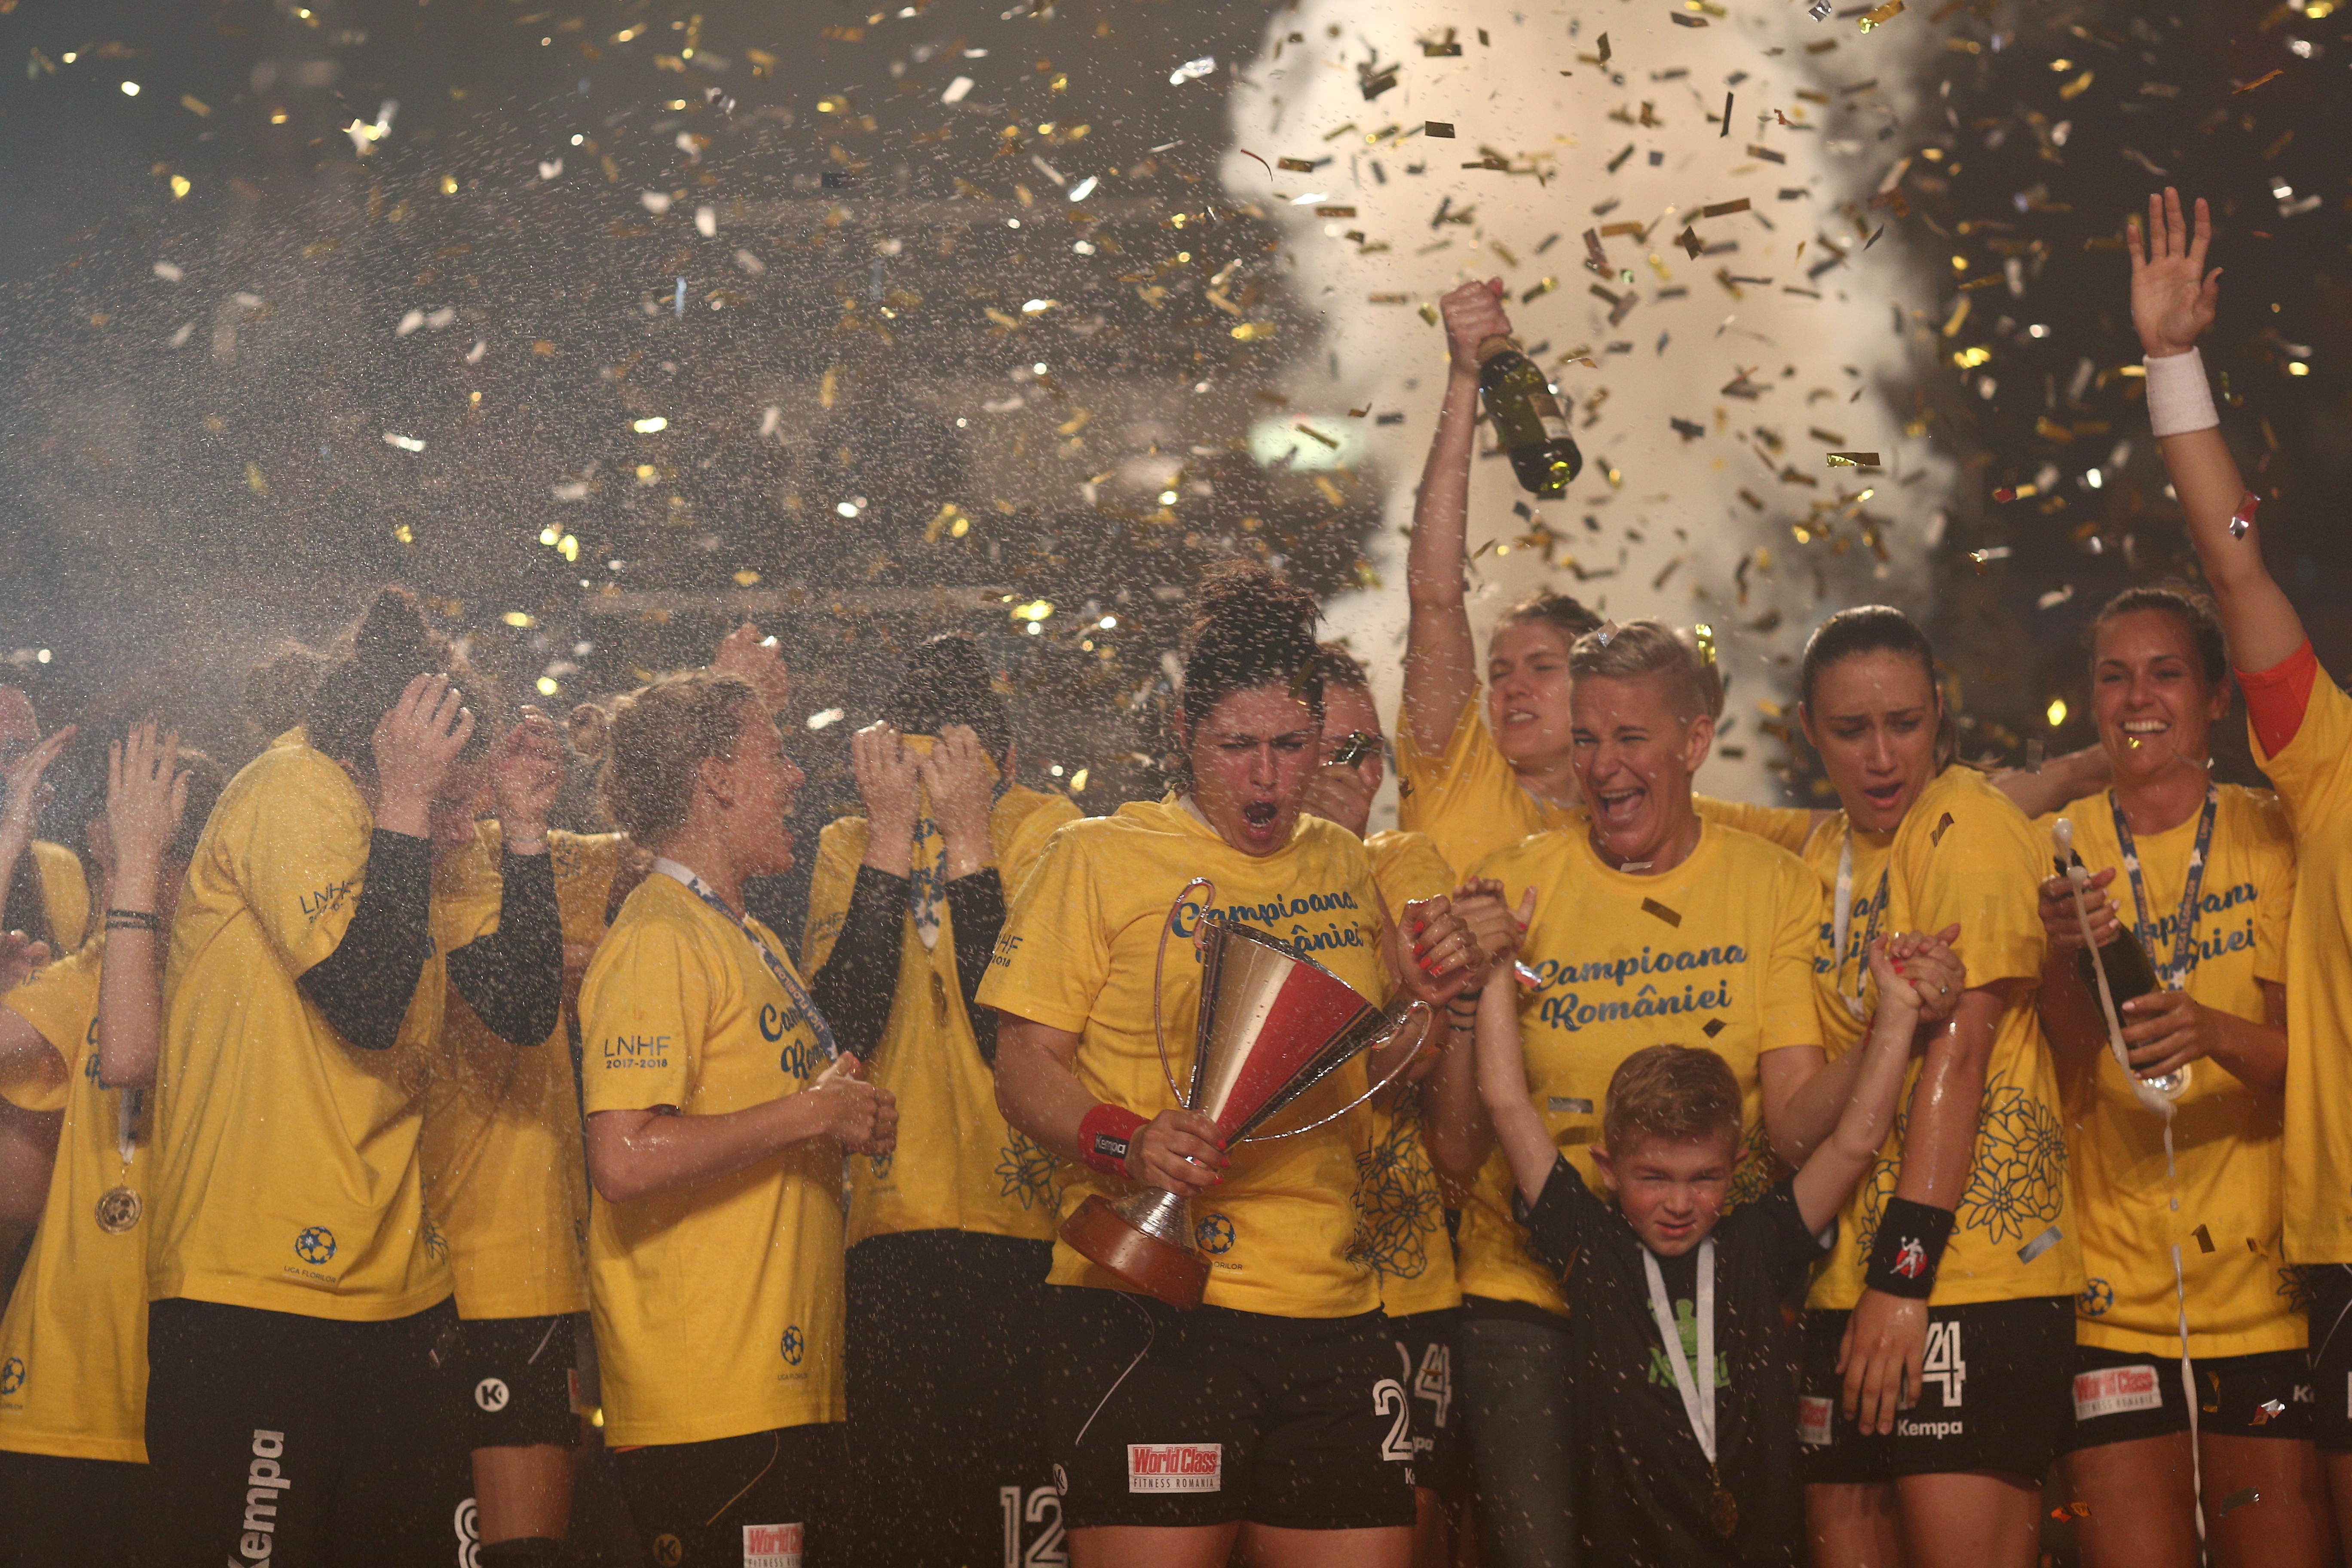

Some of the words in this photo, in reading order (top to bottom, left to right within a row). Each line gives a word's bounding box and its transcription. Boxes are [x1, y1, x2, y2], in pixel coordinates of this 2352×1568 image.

[1533, 945, 1747, 992] Campioana
[1540, 979, 1732, 1032] României
[604, 1035, 671, 1057] LNHF
[606, 1058, 668, 1069] 2017-2018
[1095, 1134, 1127, 1156] Kempa
[284, 1265, 300, 1274] LIGA
[302, 1270, 337, 1283] FLORILOR
[1212, 1261, 1243, 1271] ORILOR
[1897, 1419, 1963, 1440] Kempa
[1133, 1447, 1182, 1474] World
[1180, 1447, 1218, 1474] Class
[1134, 1478, 1170, 1488] FITNESS
[1176, 1478, 1214, 1488] ROMANIA
[1000, 1485, 1069, 1568] 12
